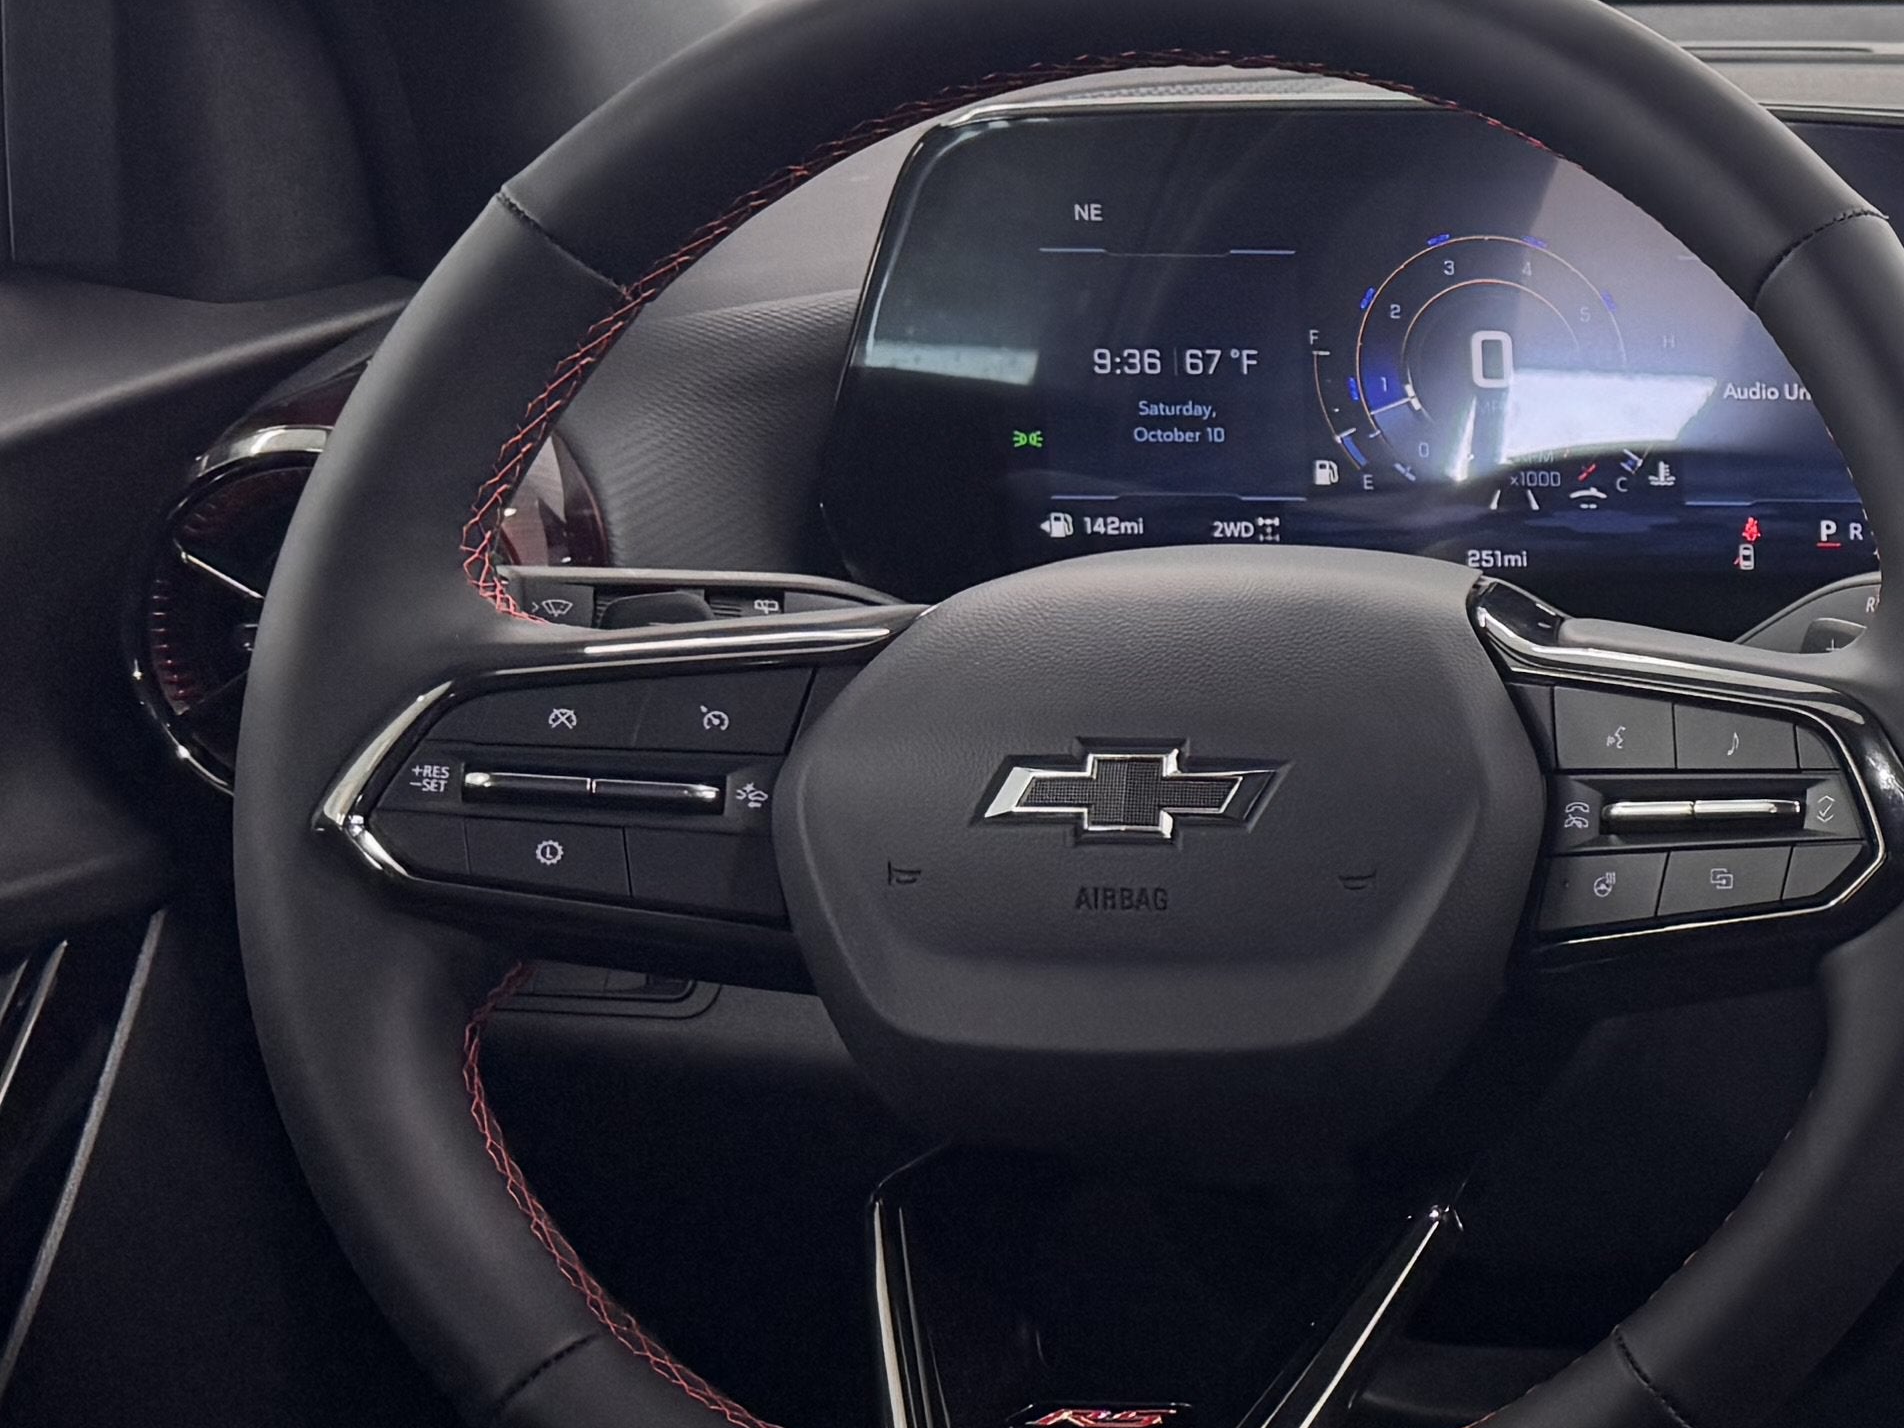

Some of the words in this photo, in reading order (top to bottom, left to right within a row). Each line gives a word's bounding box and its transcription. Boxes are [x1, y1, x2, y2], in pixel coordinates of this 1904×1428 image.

[1074, 203, 1103, 221] NE
[1444, 260, 1455, 276] 3
[1521, 262, 1532, 276] 4
[1389, 304, 1401, 319] 2
[1309, 330, 1319, 345] F
[1093, 348, 1161, 375] 9:36
[1185, 349, 1221, 375] 67
[1471, 330, 1514, 389] 0
[1380, 377, 1388, 392] 1
[1723, 382, 1779, 400] Audio
[1138, 400, 1217, 420] Saturday,
[1133, 427, 1201, 443] October
[1207, 428, 1225, 443] 10
[1363, 475, 1374, 490] E
[1510, 471, 1561, 487] x1000
[1616, 477, 1628, 492] C
[1083, 516, 1145, 536] 142mi
[1212, 521, 1254, 538] 2WD
[1820, 520, 1837, 542] P
[1848, 523, 1865, 541] R
[1467, 550, 1528, 568] 251mi
[411, 764, 450, 781] +RES
[1075, 886, 1168, 913] AIRBAG
[1026, 1407, 1177, 1428] RS
